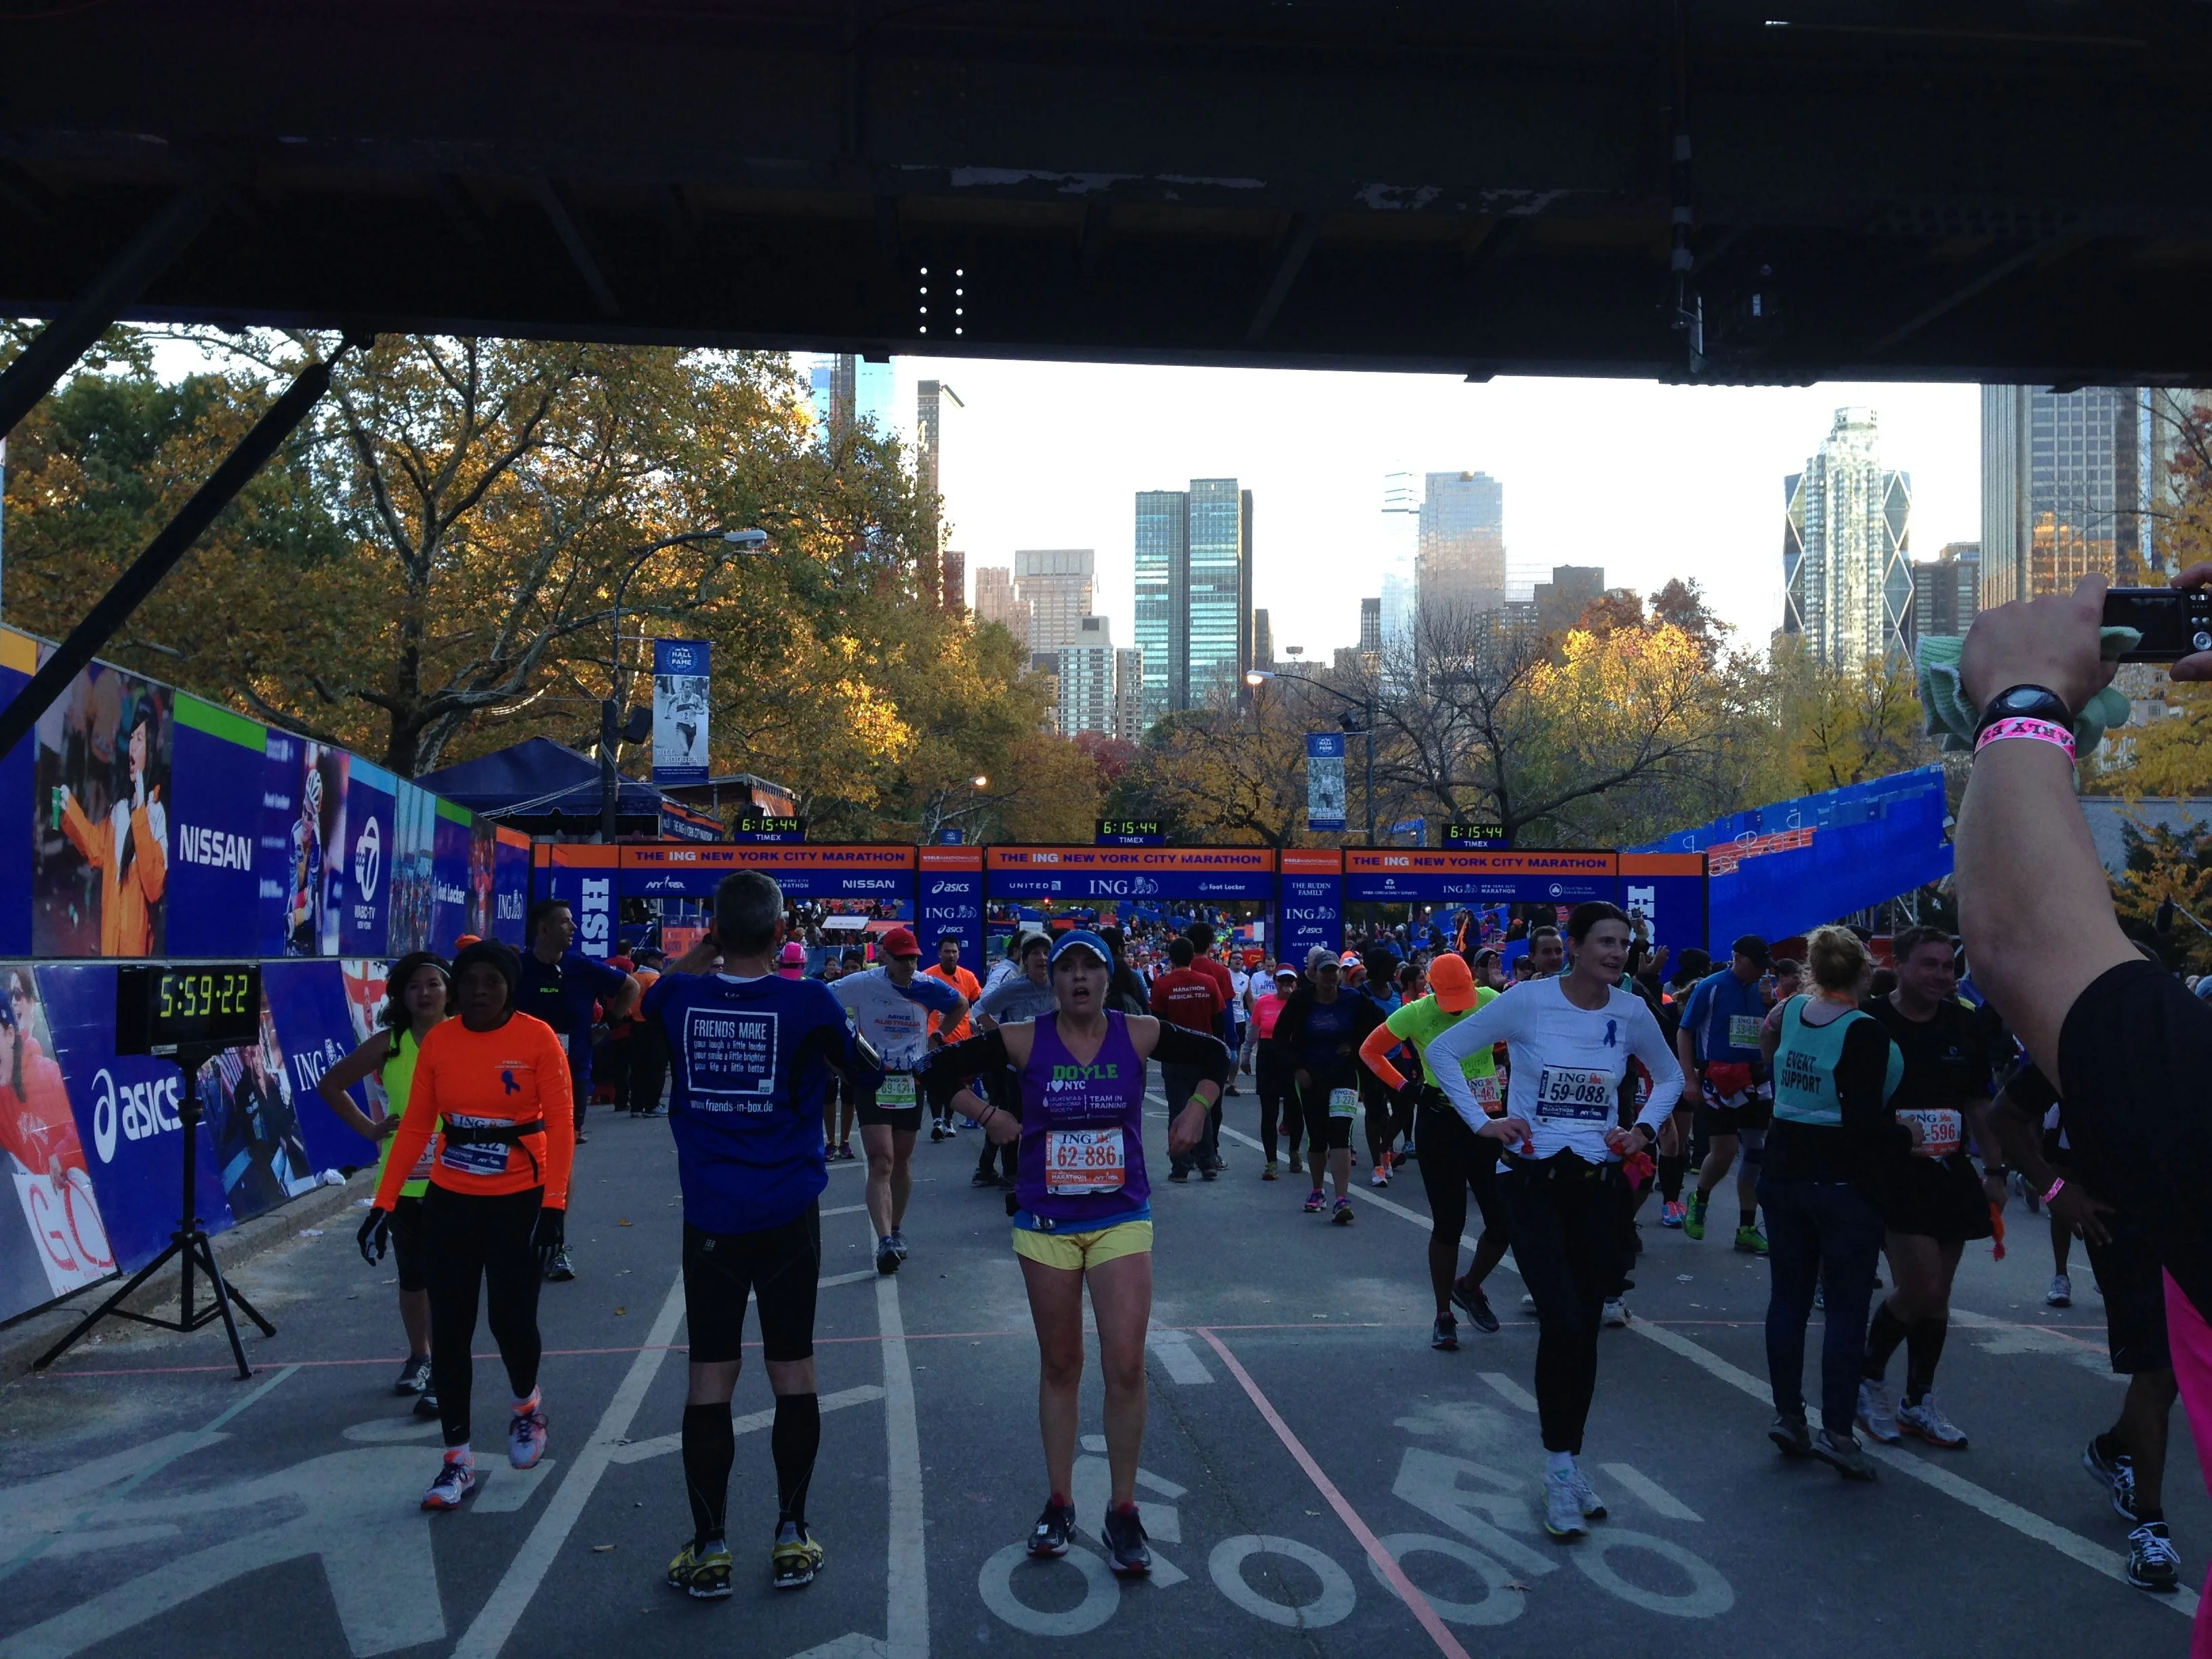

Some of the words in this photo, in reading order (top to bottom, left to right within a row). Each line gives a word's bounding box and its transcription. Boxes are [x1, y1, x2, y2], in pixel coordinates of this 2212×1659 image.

[180, 823, 252, 872] NISSAN
[635, 851, 665, 861] THE
[669, 851, 697, 861] ING
[701, 852, 734, 861] NEW
[738, 852, 779, 861] YORK
[783, 851, 818, 861] CITY
[822, 851, 905, 862] MARATHON
[1000, 853, 1028, 863] THE
[1032, 853, 1059, 863] ING
[1063, 854, 1095, 863] NEW
[1100, 854, 1139, 863] YORK
[1143, 855, 1177, 863] CITY
[1181, 855, 1261, 864] MARATHON
[1352, 857, 1380, 865] THE
[1384, 857, 1410, 866] ING
[1414, 857, 1445, 866] NEW
[1449, 857, 1488, 866] YORK
[1492, 857, 1523, 867] CITY
[1528, 858, 1607, 868] MARATHON
[842, 879, 895, 889] NISSAN
[944, 883, 970, 893] asics
[1089, 880, 1128, 895] ING
[1442, 885, 1463, 893] ING
[497, 894, 512, 920] ING
[925, 907, 955, 919] ING
[1286, 908, 1315, 920] ING
[874, 1019, 921, 1027] AUSTRALIA
[693, 1019, 735, 1038] FRIENDS
[739, 1021, 767, 1040] MAKE
[693, 1040, 706, 1050] your
[709, 1039, 724, 1050] laugh
[733, 1040, 746, 1050] little
[748, 1041, 766, 1052] louder
[693, 1051, 706, 1061] your
[708, 1051, 723, 1061] smile
[729, 1051, 742, 1061] little
[743, 1052, 766, 1063] brighter
[1786, 1050, 1817, 1073] EVENT
[292, 1052, 327, 1092] ING
[695, 1063, 706, 1071] your
[710, 1062, 719, 1071] life
[723, 1064, 727, 1072] a
[731, 1063, 744, 1072] little
[747, 1063, 765, 1073] better
[1052, 1064, 1119, 1080] DOYLE
[1557, 1072, 1586, 1084] ING
[1780, 1067, 1822, 1094] SUPPORT
[1046, 1081, 1050, 1092] I
[1064, 1080, 1086, 1091] NYC
[1549, 1082, 1605, 1103] 59-088
[122, 1076, 183, 1141] asics
[459, 1116, 485, 1128] ING
[1917, 1113, 1937, 1123] NG
[1062, 1134, 1091, 1144] ING
[1057, 1145, 1117, 1167] 62-886
[29, 1180, 115, 1272] GO
